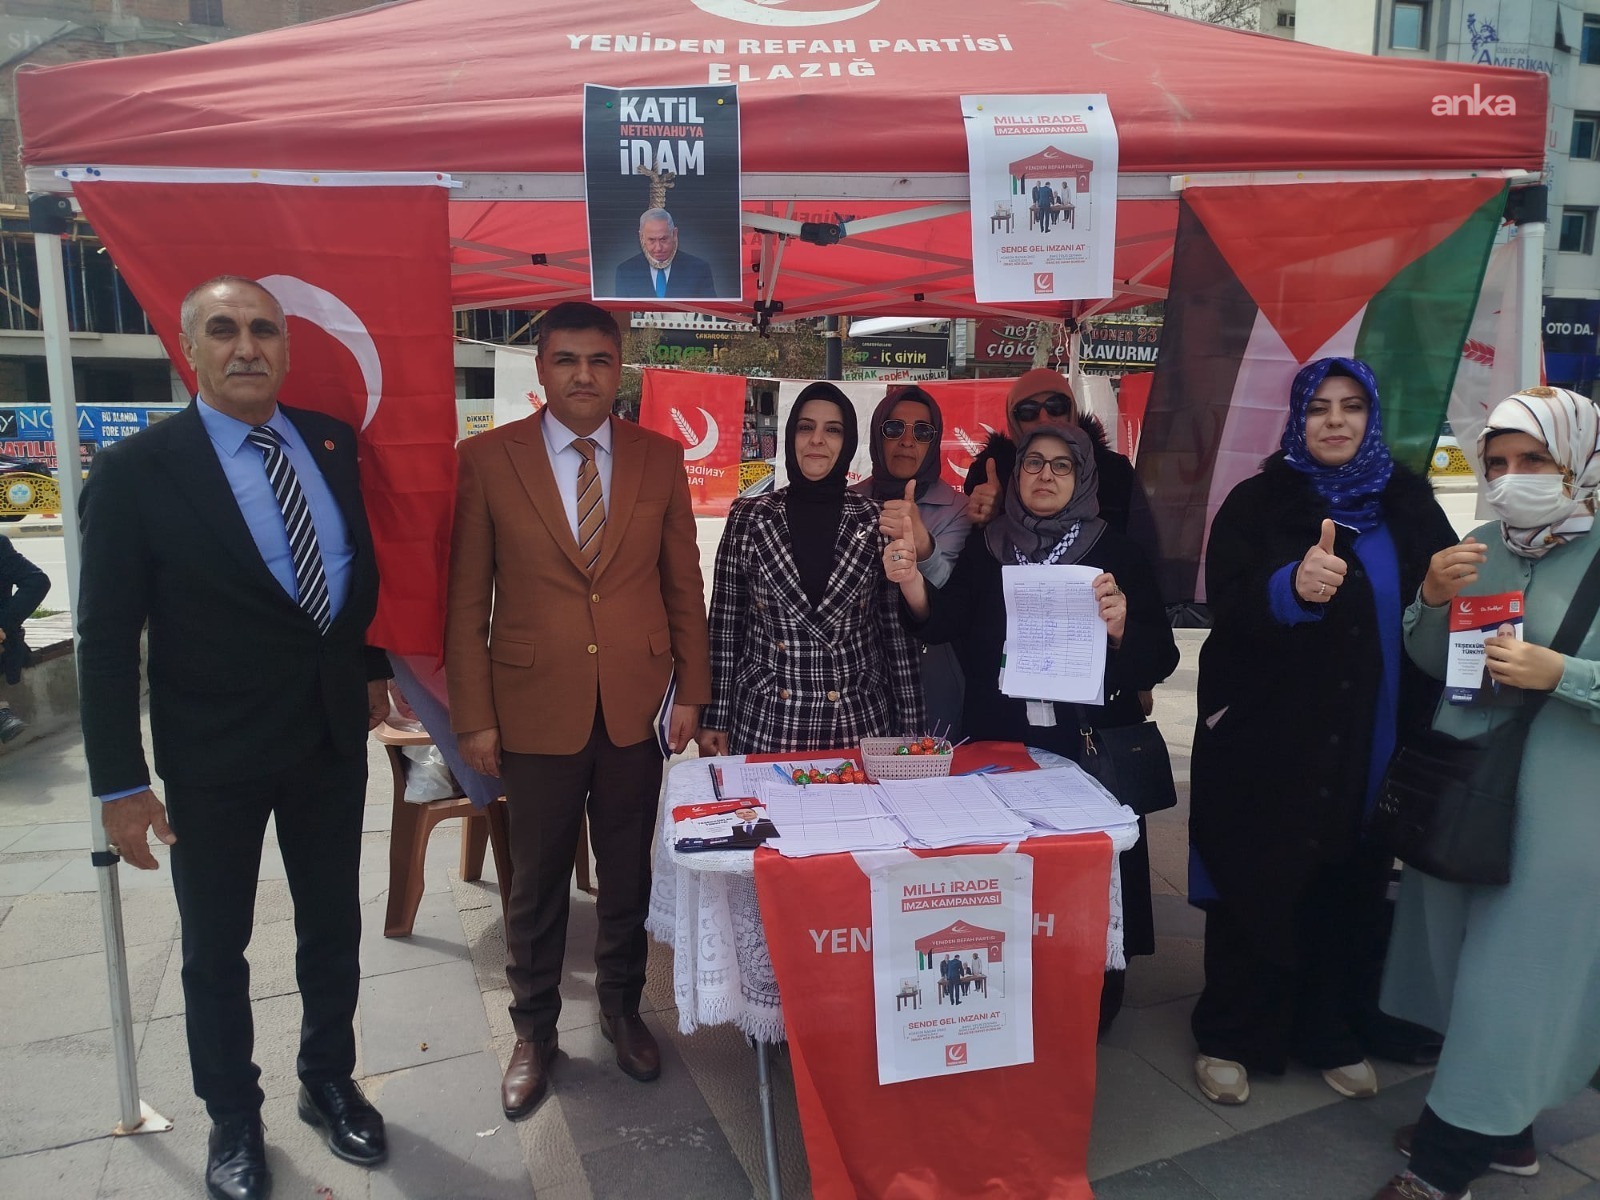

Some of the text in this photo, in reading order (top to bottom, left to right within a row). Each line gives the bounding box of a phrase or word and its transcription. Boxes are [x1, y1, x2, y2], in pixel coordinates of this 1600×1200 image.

[566, 31, 1014, 54] YENİDEN REFAH PARTİSİ
[707, 57, 876, 85] ELAZIĞ
[620, 96, 705, 124] KATİL
[620, 124, 704, 138] NETENYAHU'YA
[620, 139, 705, 176] İDAM
[1001, 246, 1028, 254] SENDE
[1075, 243, 1086, 251] AT
[1091, 325, 1158, 343] DÖNER 23
[1546, 322, 1594, 335] OTO DA.
[881, 350, 892, 365] İÇ
[895, 350, 927, 364] GİYİM
[112, 412, 138, 423] ALANDA
[908, 1020, 938, 1030] SENDE
[939, 1017, 957, 1026] GEL
[989, 1011, 1001, 1019] AT
